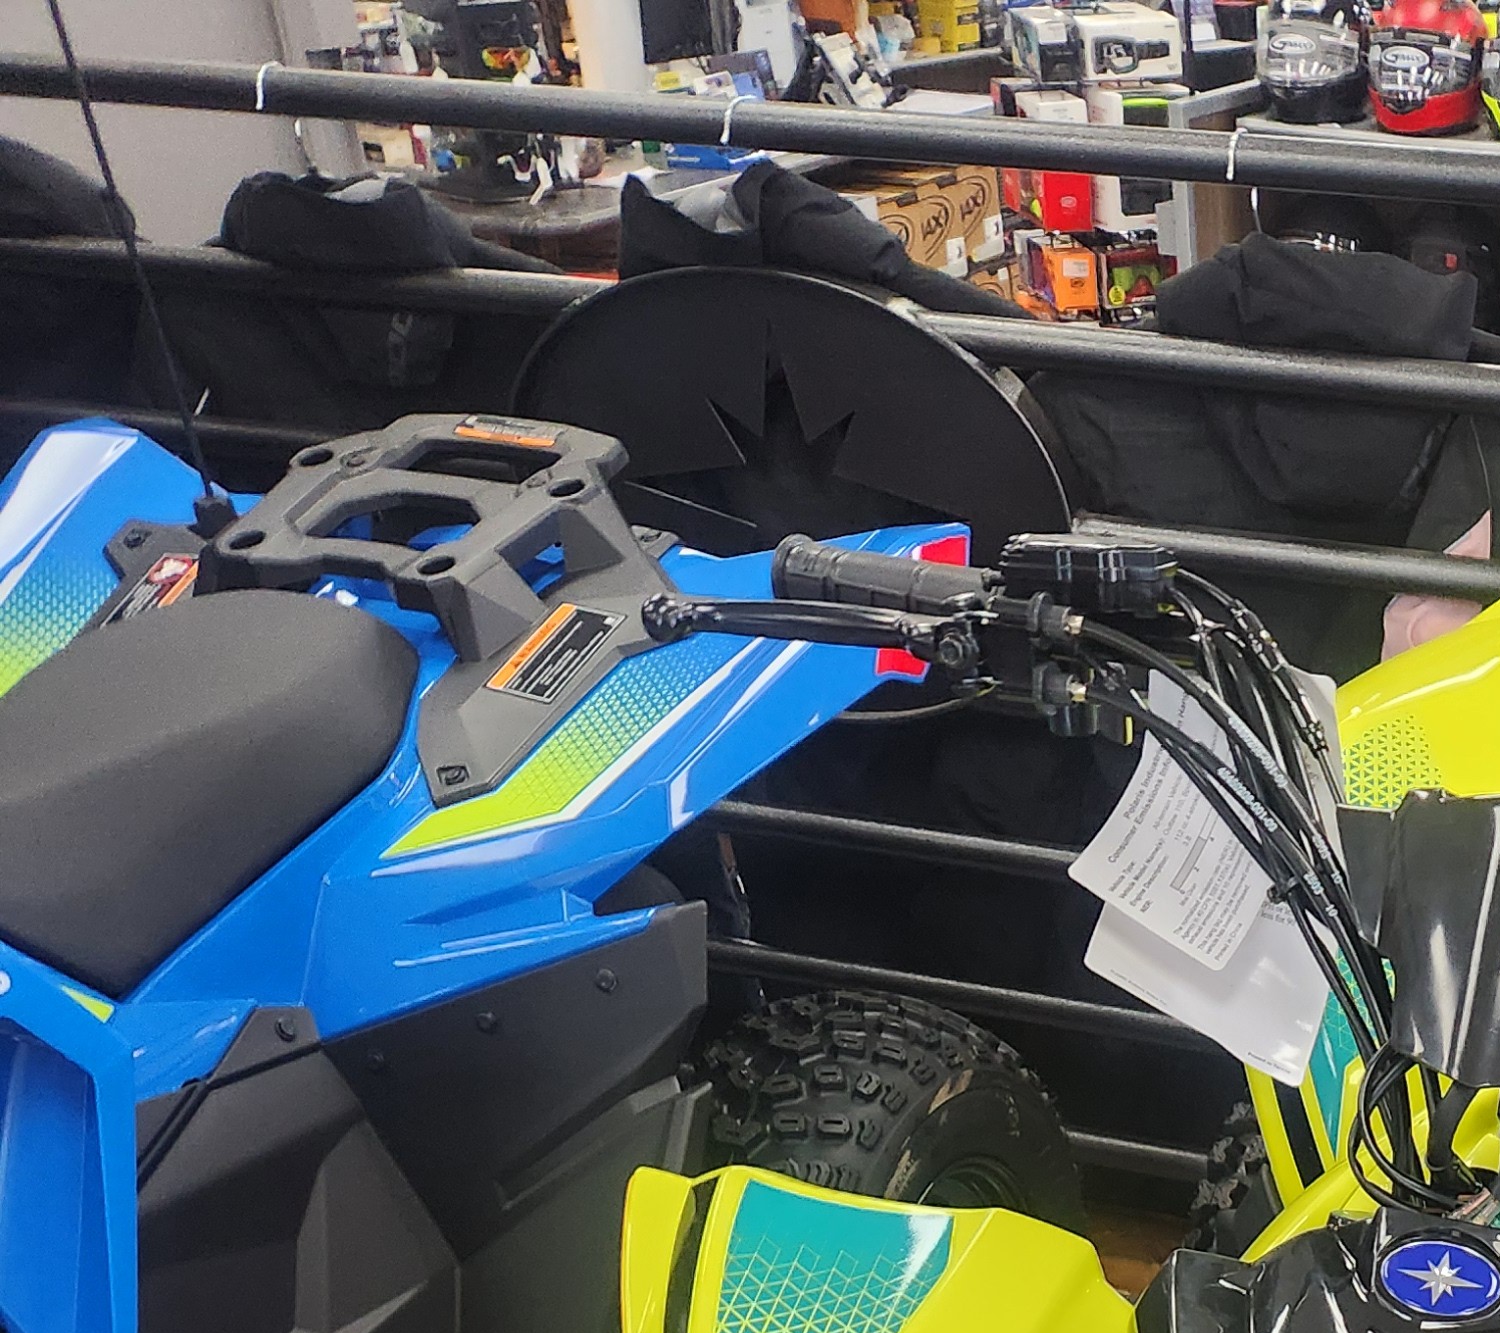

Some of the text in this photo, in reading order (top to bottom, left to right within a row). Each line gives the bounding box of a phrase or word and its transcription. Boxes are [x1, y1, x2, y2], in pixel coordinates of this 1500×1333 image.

[1107, 825, 1137, 863] Consumer
[1134, 779, 1163, 825] Emissions
[1123, 789, 1145, 819] Polaris
